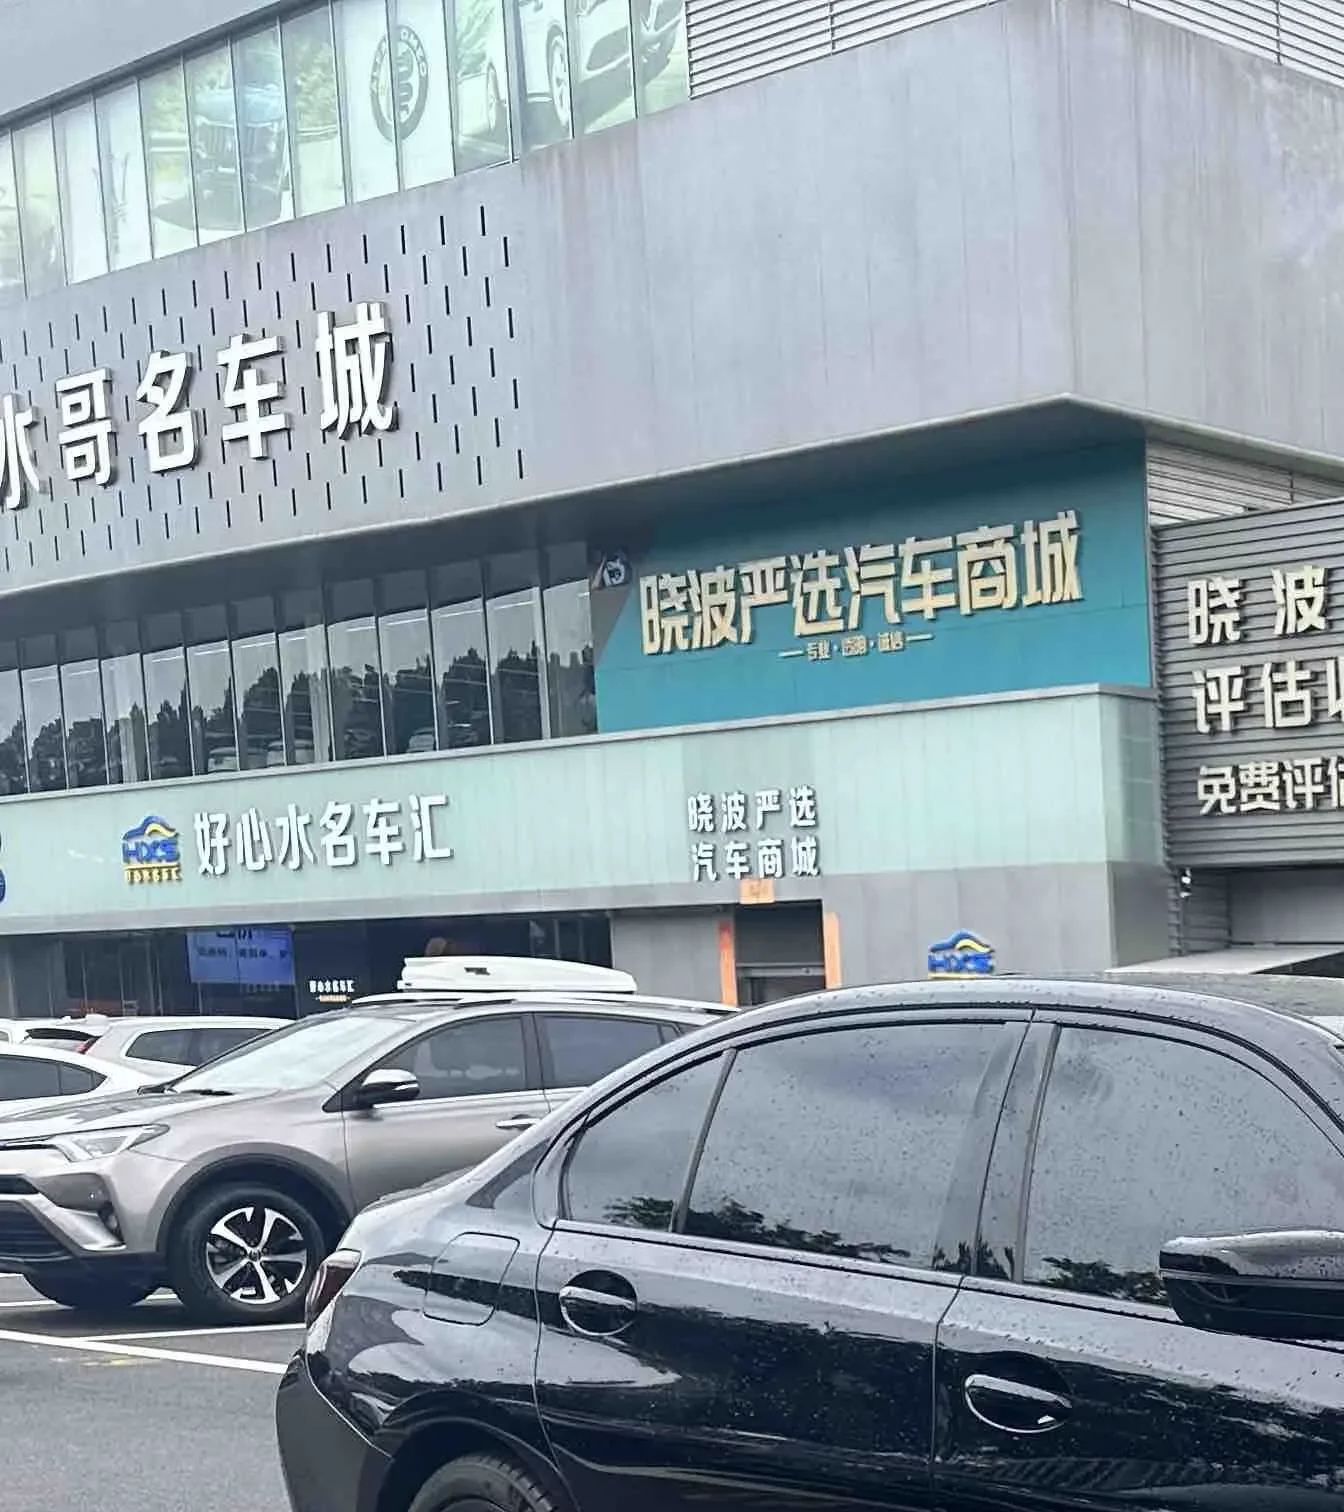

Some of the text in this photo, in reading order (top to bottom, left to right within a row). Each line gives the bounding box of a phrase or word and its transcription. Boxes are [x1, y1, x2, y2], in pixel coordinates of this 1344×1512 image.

[639, 510, 1084, 655] 晓波严选汽车商城
[194, 793, 454, 876] 好心水名车汇
[687, 785, 817, 833] 晓波严选
[690, 836, 821, 881] 汽车商城
